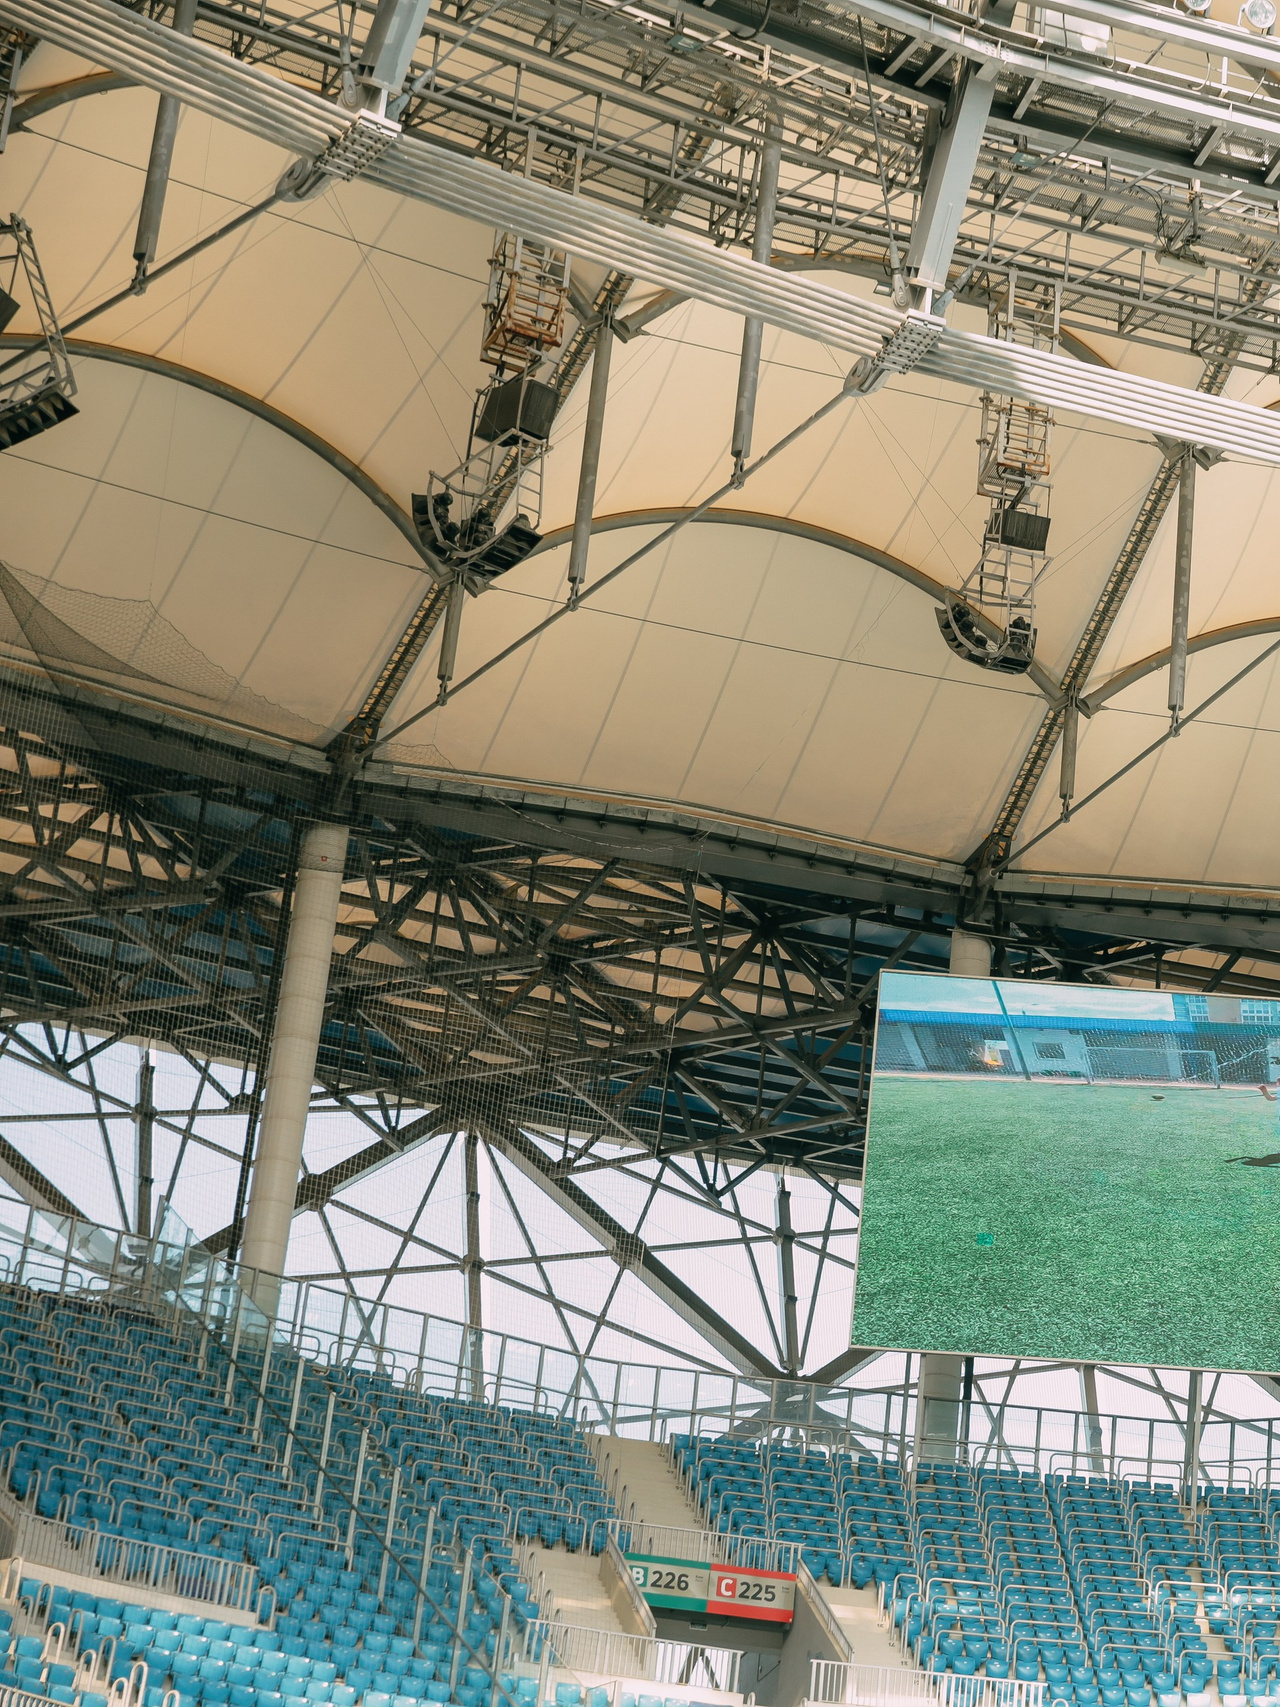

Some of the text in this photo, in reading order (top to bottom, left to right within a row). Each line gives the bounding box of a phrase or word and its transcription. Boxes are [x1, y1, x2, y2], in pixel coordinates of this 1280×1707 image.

[632, 1567, 689, 1591] B 226
[720, 1578, 776, 1602] C 225
